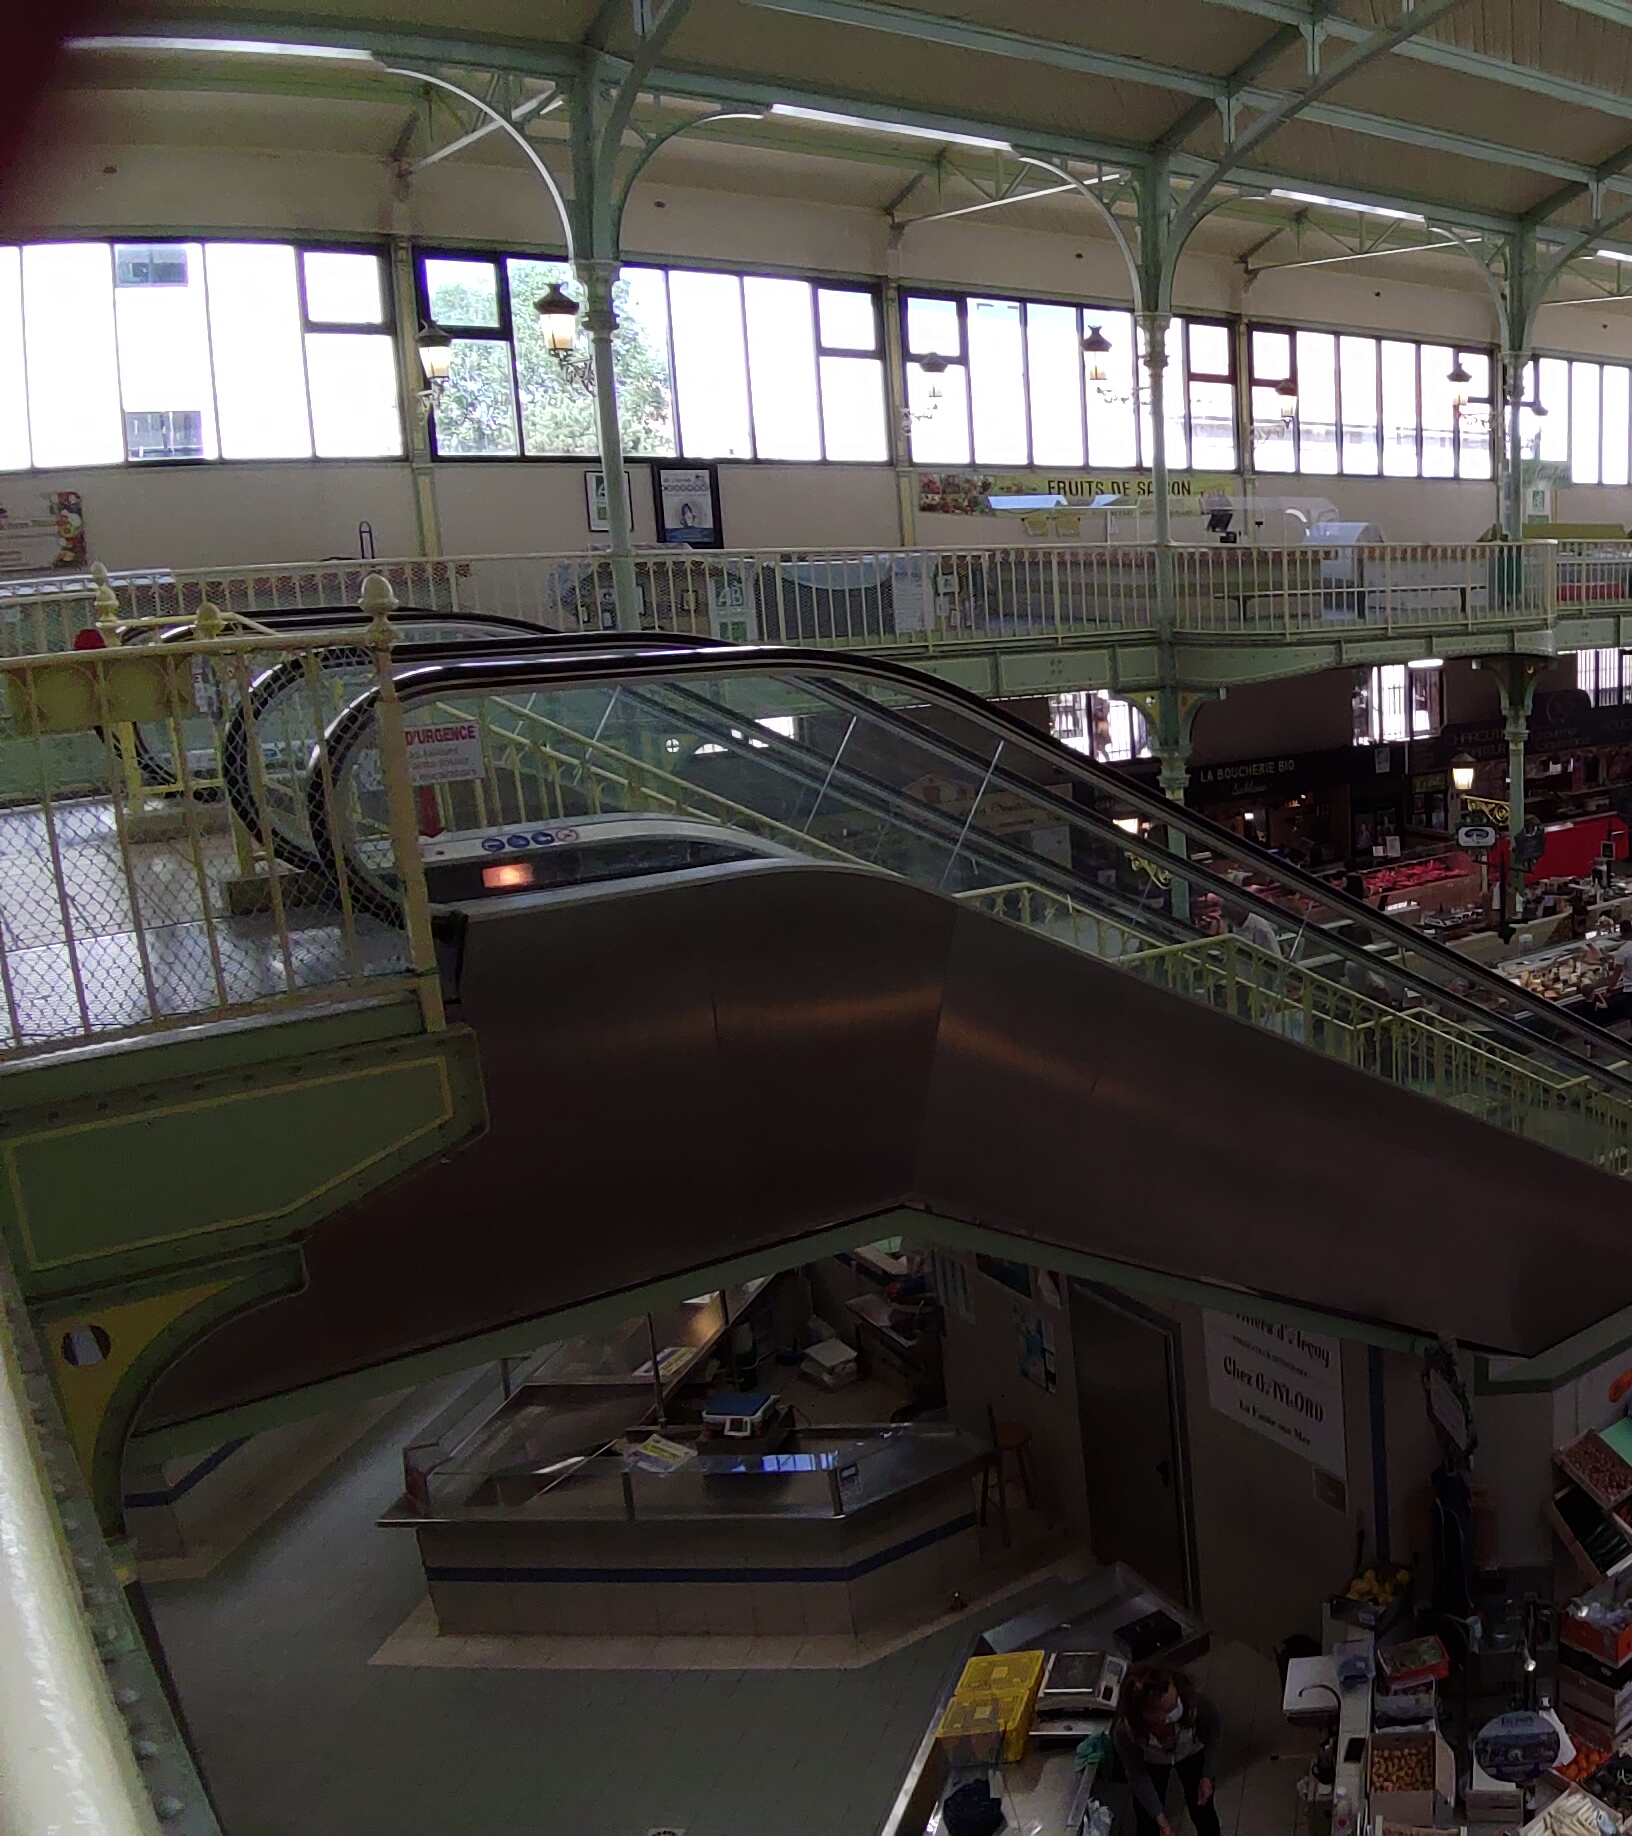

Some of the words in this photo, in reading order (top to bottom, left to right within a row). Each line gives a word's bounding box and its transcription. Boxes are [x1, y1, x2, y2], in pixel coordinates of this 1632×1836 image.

[1047, 480, 1104, 496] FRUITS
[1111, 481, 1131, 497] DE
[1137, 480, 1191, 497] SASON
[405, 725, 476, 746] D'URGENCE
[1200, 770, 1215, 783] LA
[1216, 761, 1276, 780] BOUCHERIE
[1278, 759, 1296, 773] BIO
[1223, 1355, 1253, 1387] Chez
